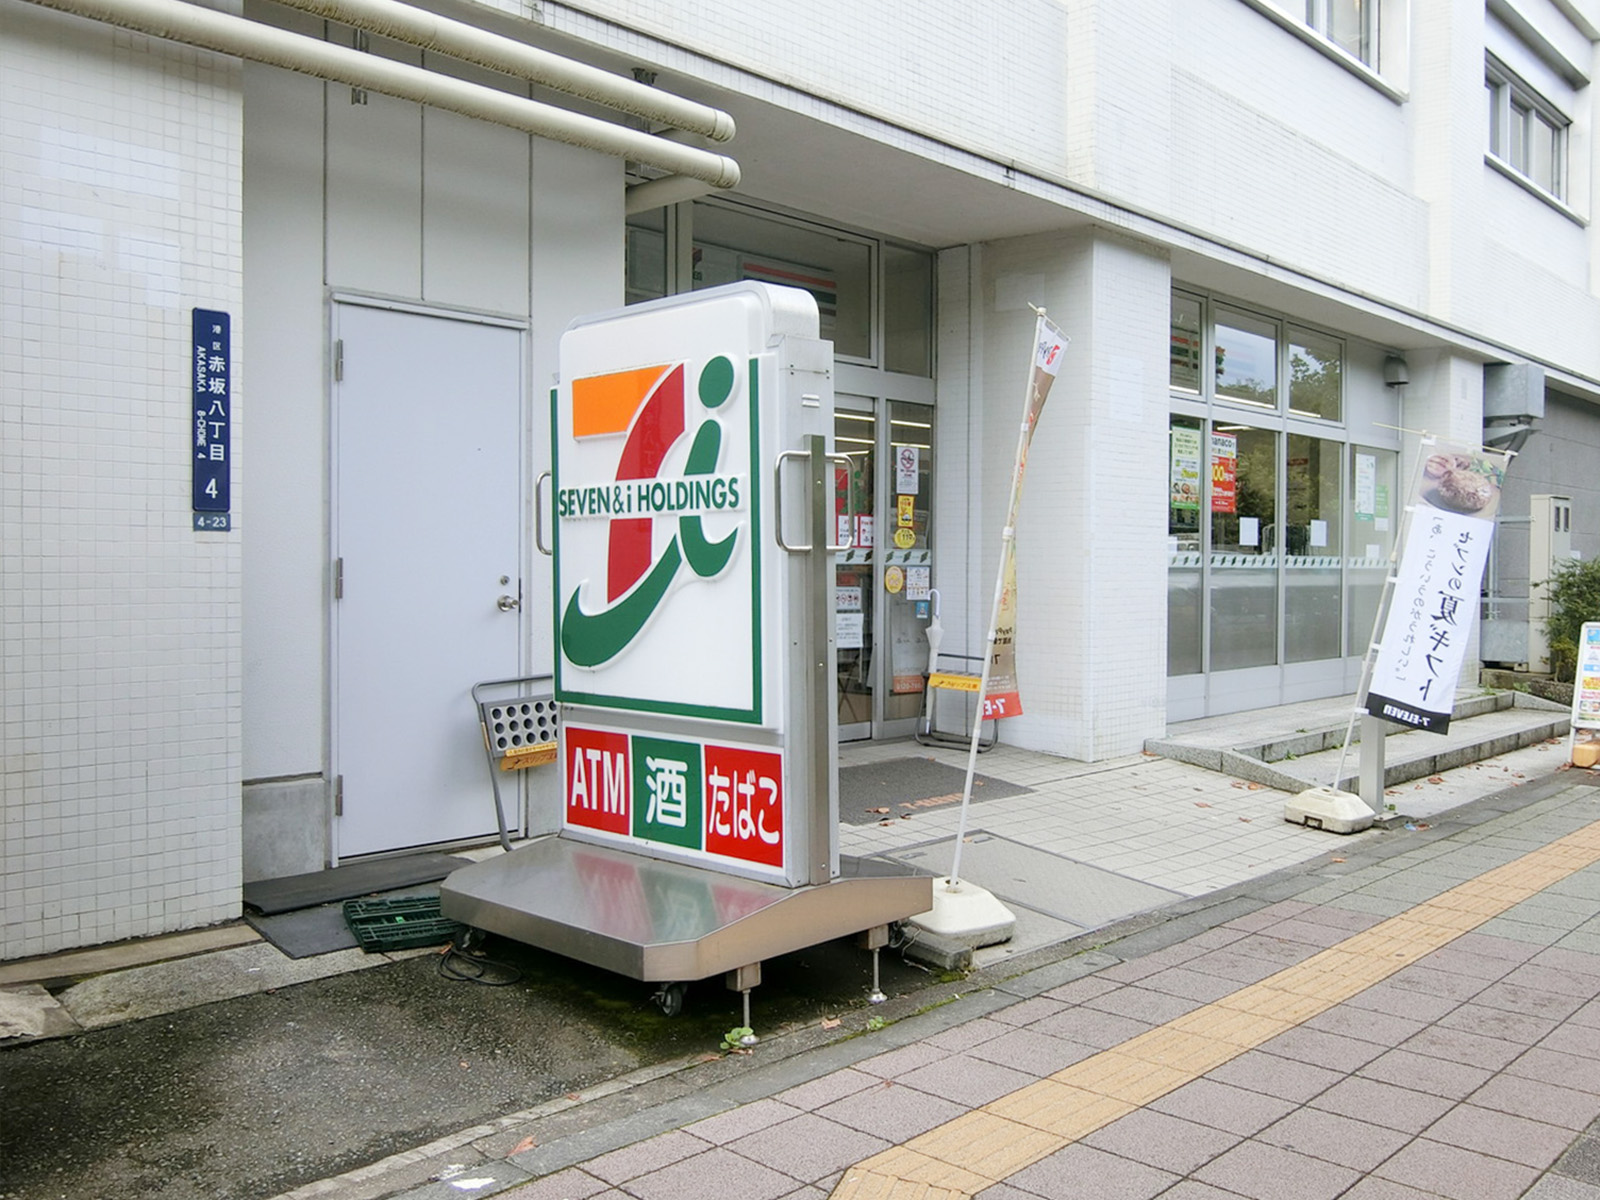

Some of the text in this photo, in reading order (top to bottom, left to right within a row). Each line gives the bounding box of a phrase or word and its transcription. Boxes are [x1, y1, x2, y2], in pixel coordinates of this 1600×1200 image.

[196, 345, 206, 393] AKASAKA
[208, 355, 226, 461] 赤坂八丁目
[204, 478, 218, 499] 4
[637, 477, 740, 512] HOLDINGS
[197, 516, 227, 528] 4-23
[571, 747, 625, 816] ATM
[646, 755, 688, 828] 酒
[708, 765, 780, 844] たばこ
